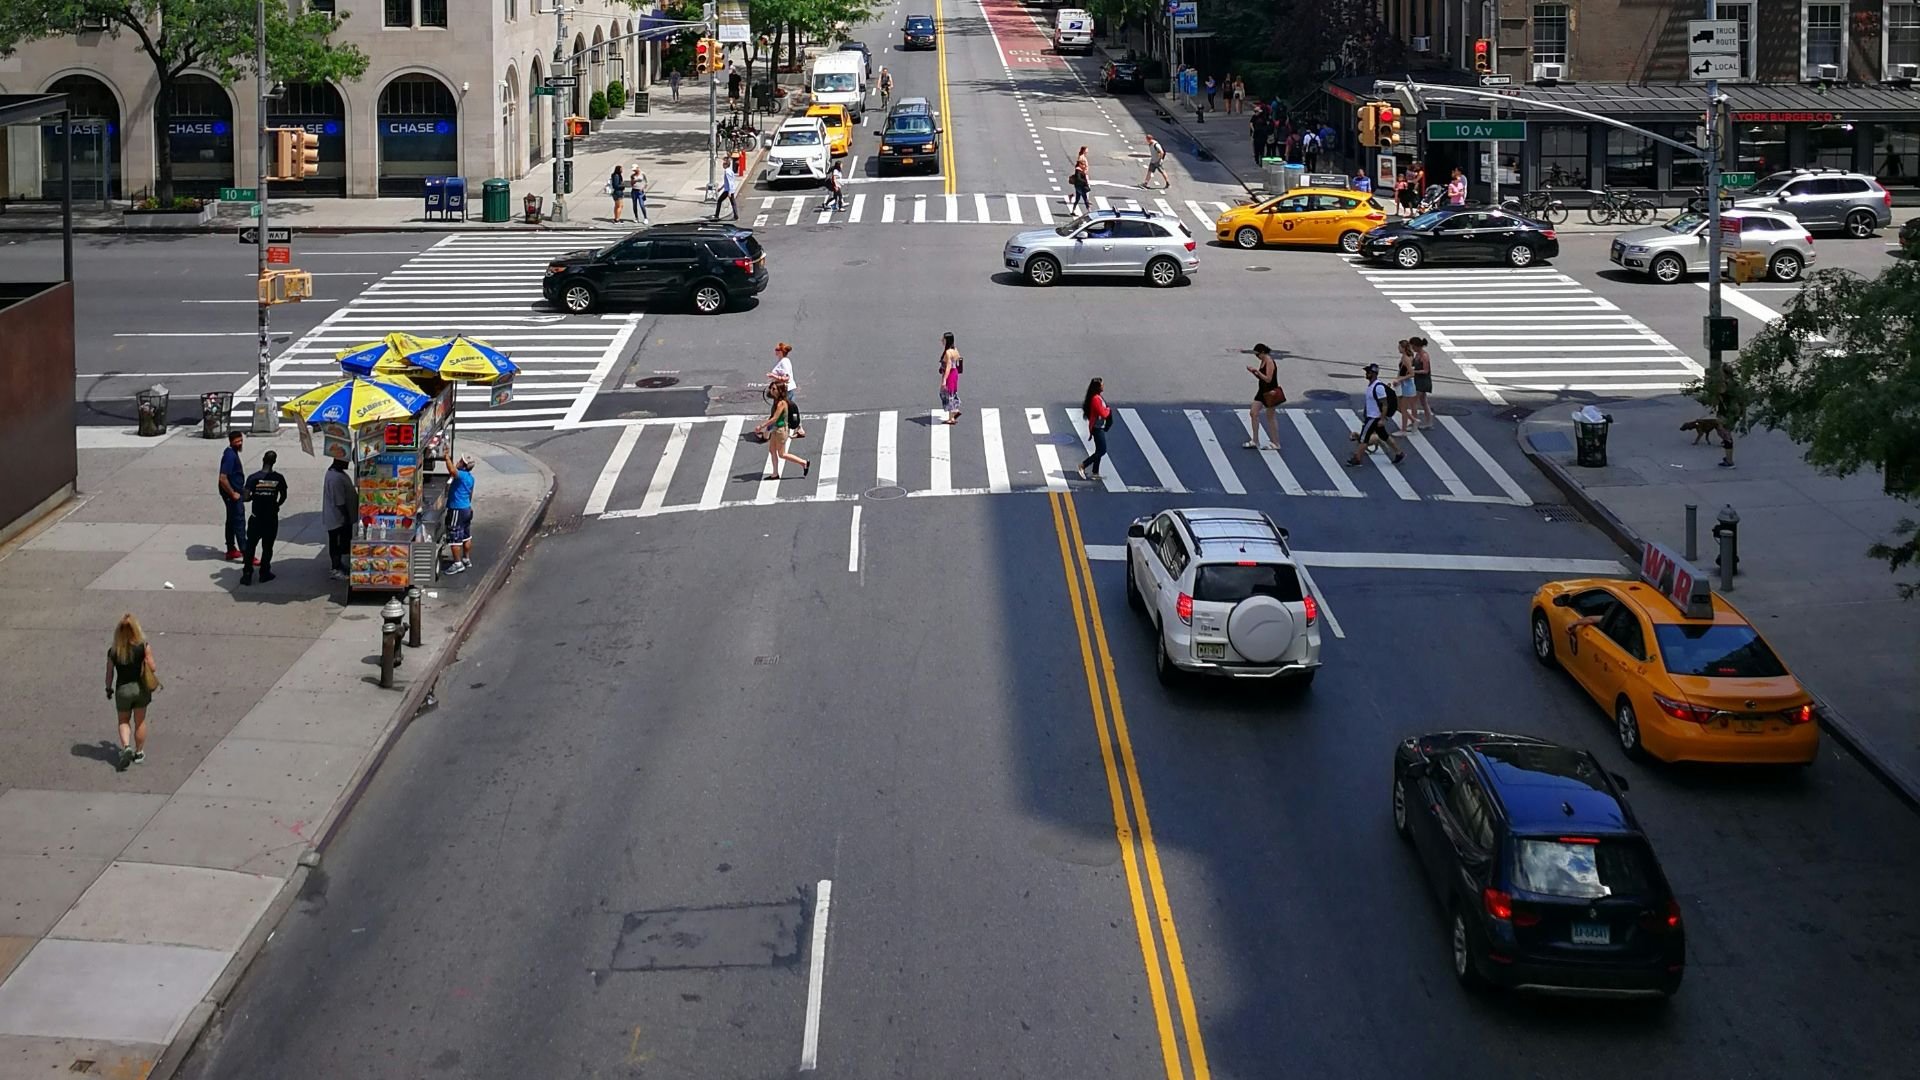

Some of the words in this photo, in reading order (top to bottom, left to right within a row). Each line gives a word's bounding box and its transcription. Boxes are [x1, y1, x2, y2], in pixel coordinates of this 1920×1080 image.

[1716, 27, 1737, 35] TRUCK
[1716, 38, 1737, 46] ROUTE
[1714, 63, 1738, 71] LOCAL
[1738, 112, 1766, 121] YORK
[1769, 112, 1812, 121] BURGER
[54, 124, 100, 135] CASE
[390, 122, 435, 133] CHASE
[1455, 125, 1470, 136] 10
[1473, 125, 1493, 136] Av
[1727, 174, 1738, 184] 10
[225, 189, 238, 200] 10
[268, 231, 285, 240] WAY
[356, 398, 392, 418] SABRETT
